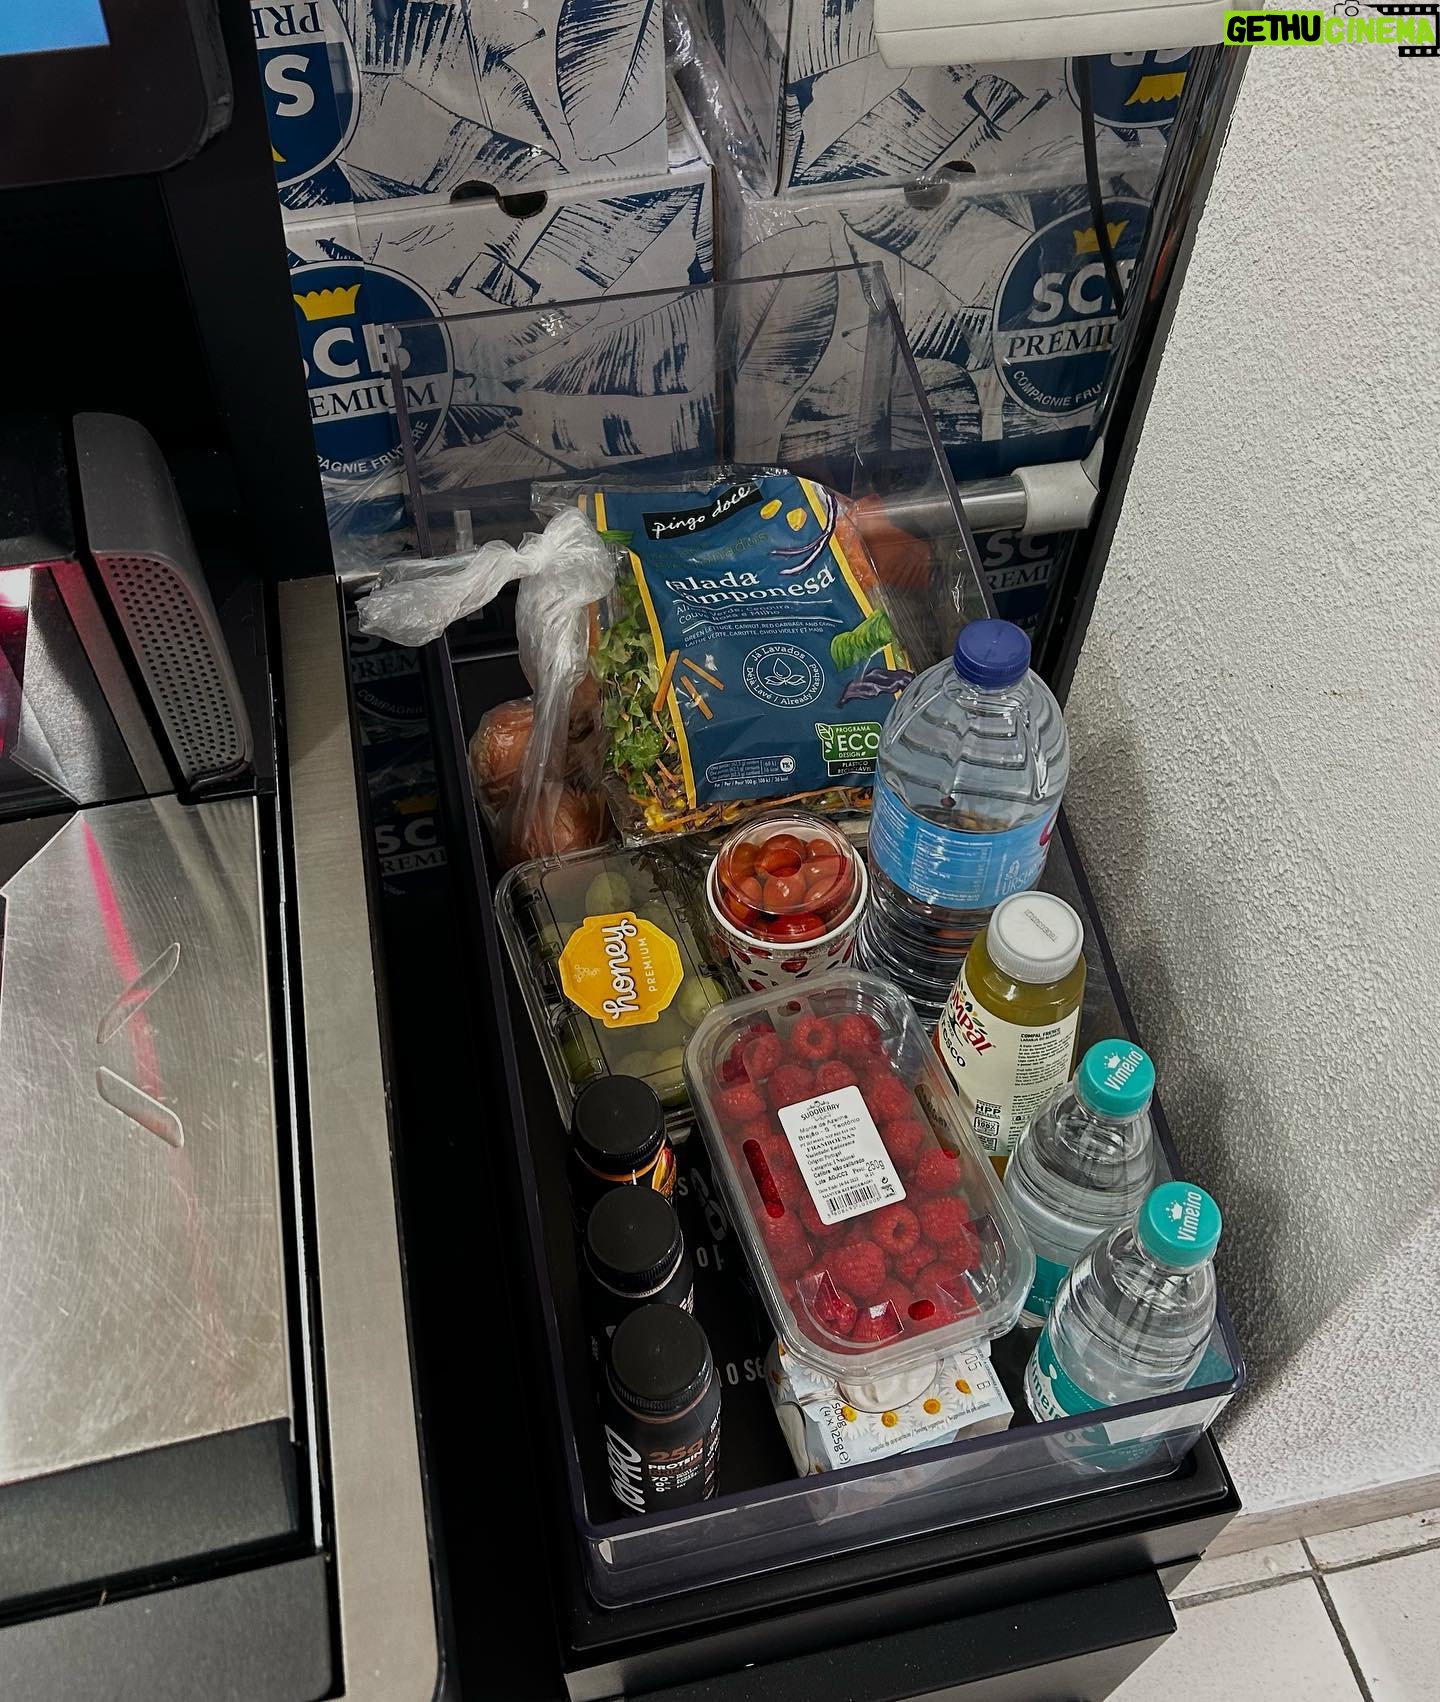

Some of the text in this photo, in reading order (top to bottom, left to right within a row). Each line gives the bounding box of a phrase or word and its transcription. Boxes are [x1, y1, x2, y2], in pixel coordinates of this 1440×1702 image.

[303, 324, 411, 378] CB
[1013, 370, 1104, 406] COMPAGNIE FRU
[651, 486, 751, 540] pingo doce
[761, 645, 806, 660] Lavados
[753, 684, 773, 699] Lavé
[780, 693, 813, 705] Already
[809, 663, 822, 695] Washed
[837, 732, 880, 751] ECO
[602, 919, 640, 1019] honey
[639, 937, 658, 992] PREMIUM
[1104, 1047, 1144, 1092] Vimeiro
[800, 1103, 840, 1121] SUDOBERRY
[975, 1103, 1001, 1114] HPP
[865, 1159, 885, 1173] 250g
[1177, 1189, 1202, 1242] Vimeiro
[831, 1402, 847, 1428] 500g
[830, 1426, 844, 1452] 125g
[648, 1448, 703, 1471] PROTEIN
